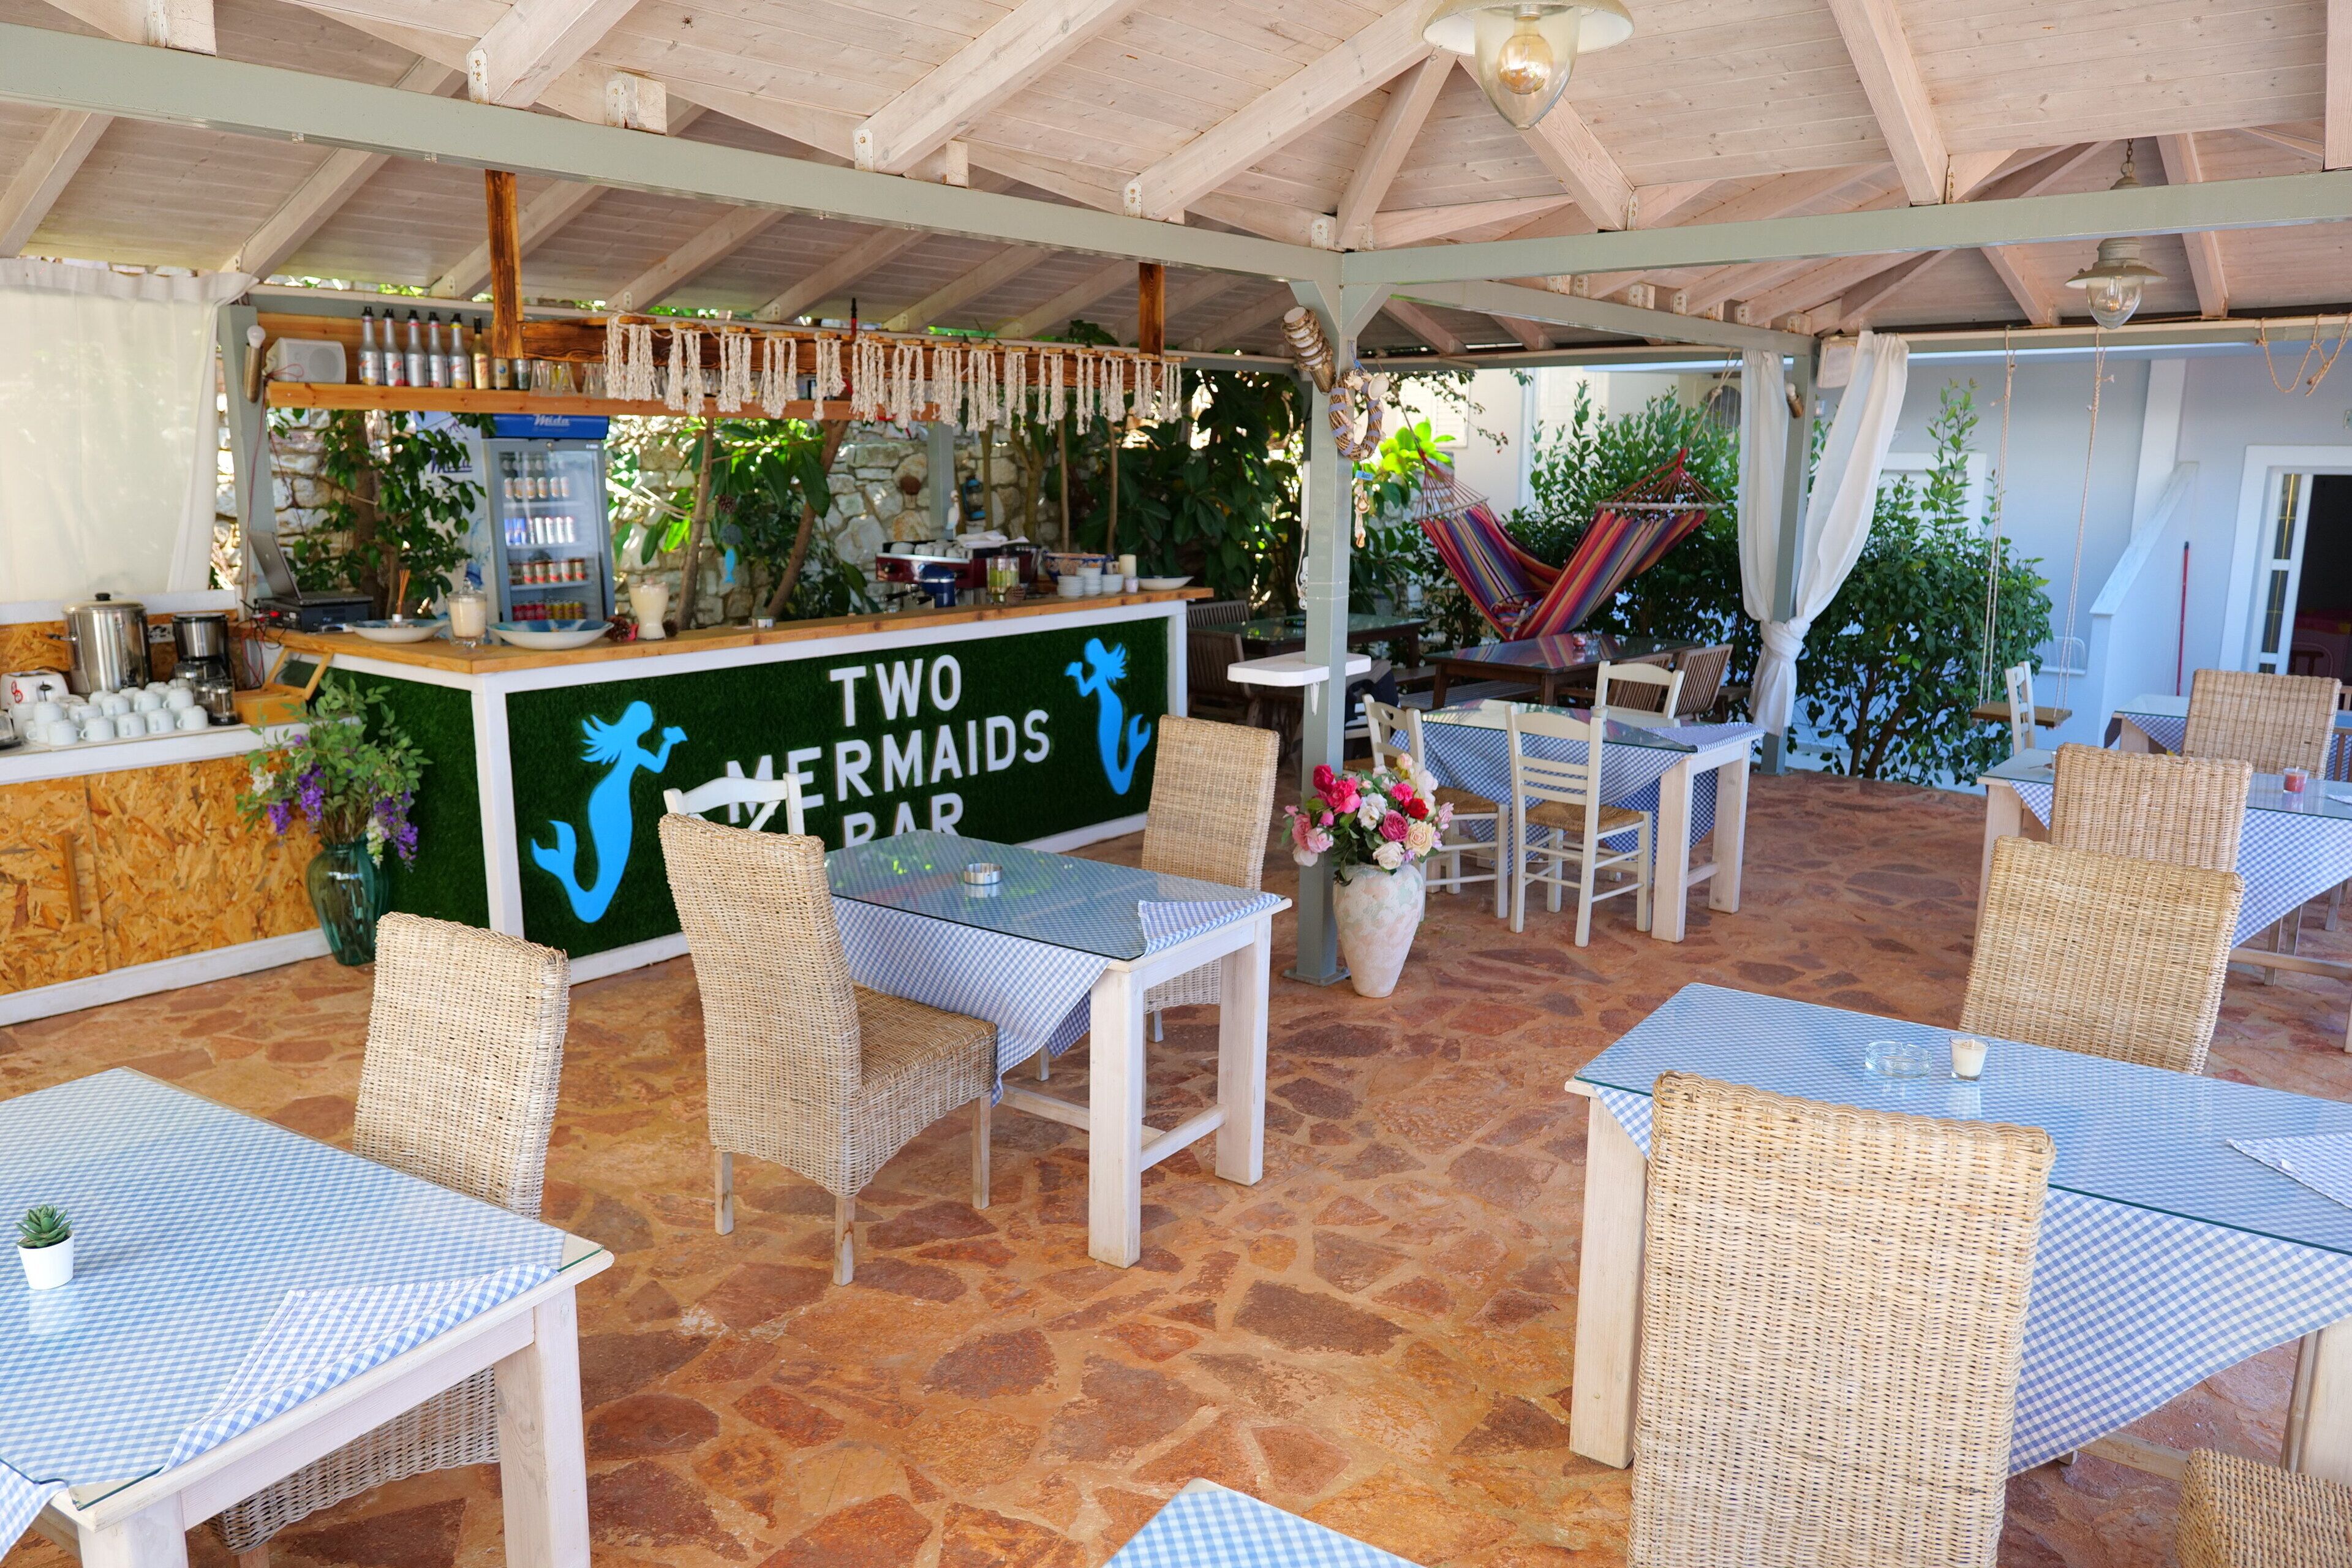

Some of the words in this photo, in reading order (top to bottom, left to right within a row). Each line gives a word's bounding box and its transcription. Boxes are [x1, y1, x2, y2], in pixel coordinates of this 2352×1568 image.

[830, 654, 962, 727] TWO
[726, 709, 1051, 824] MERMAIDS
[842, 793, 964, 848] BAR
